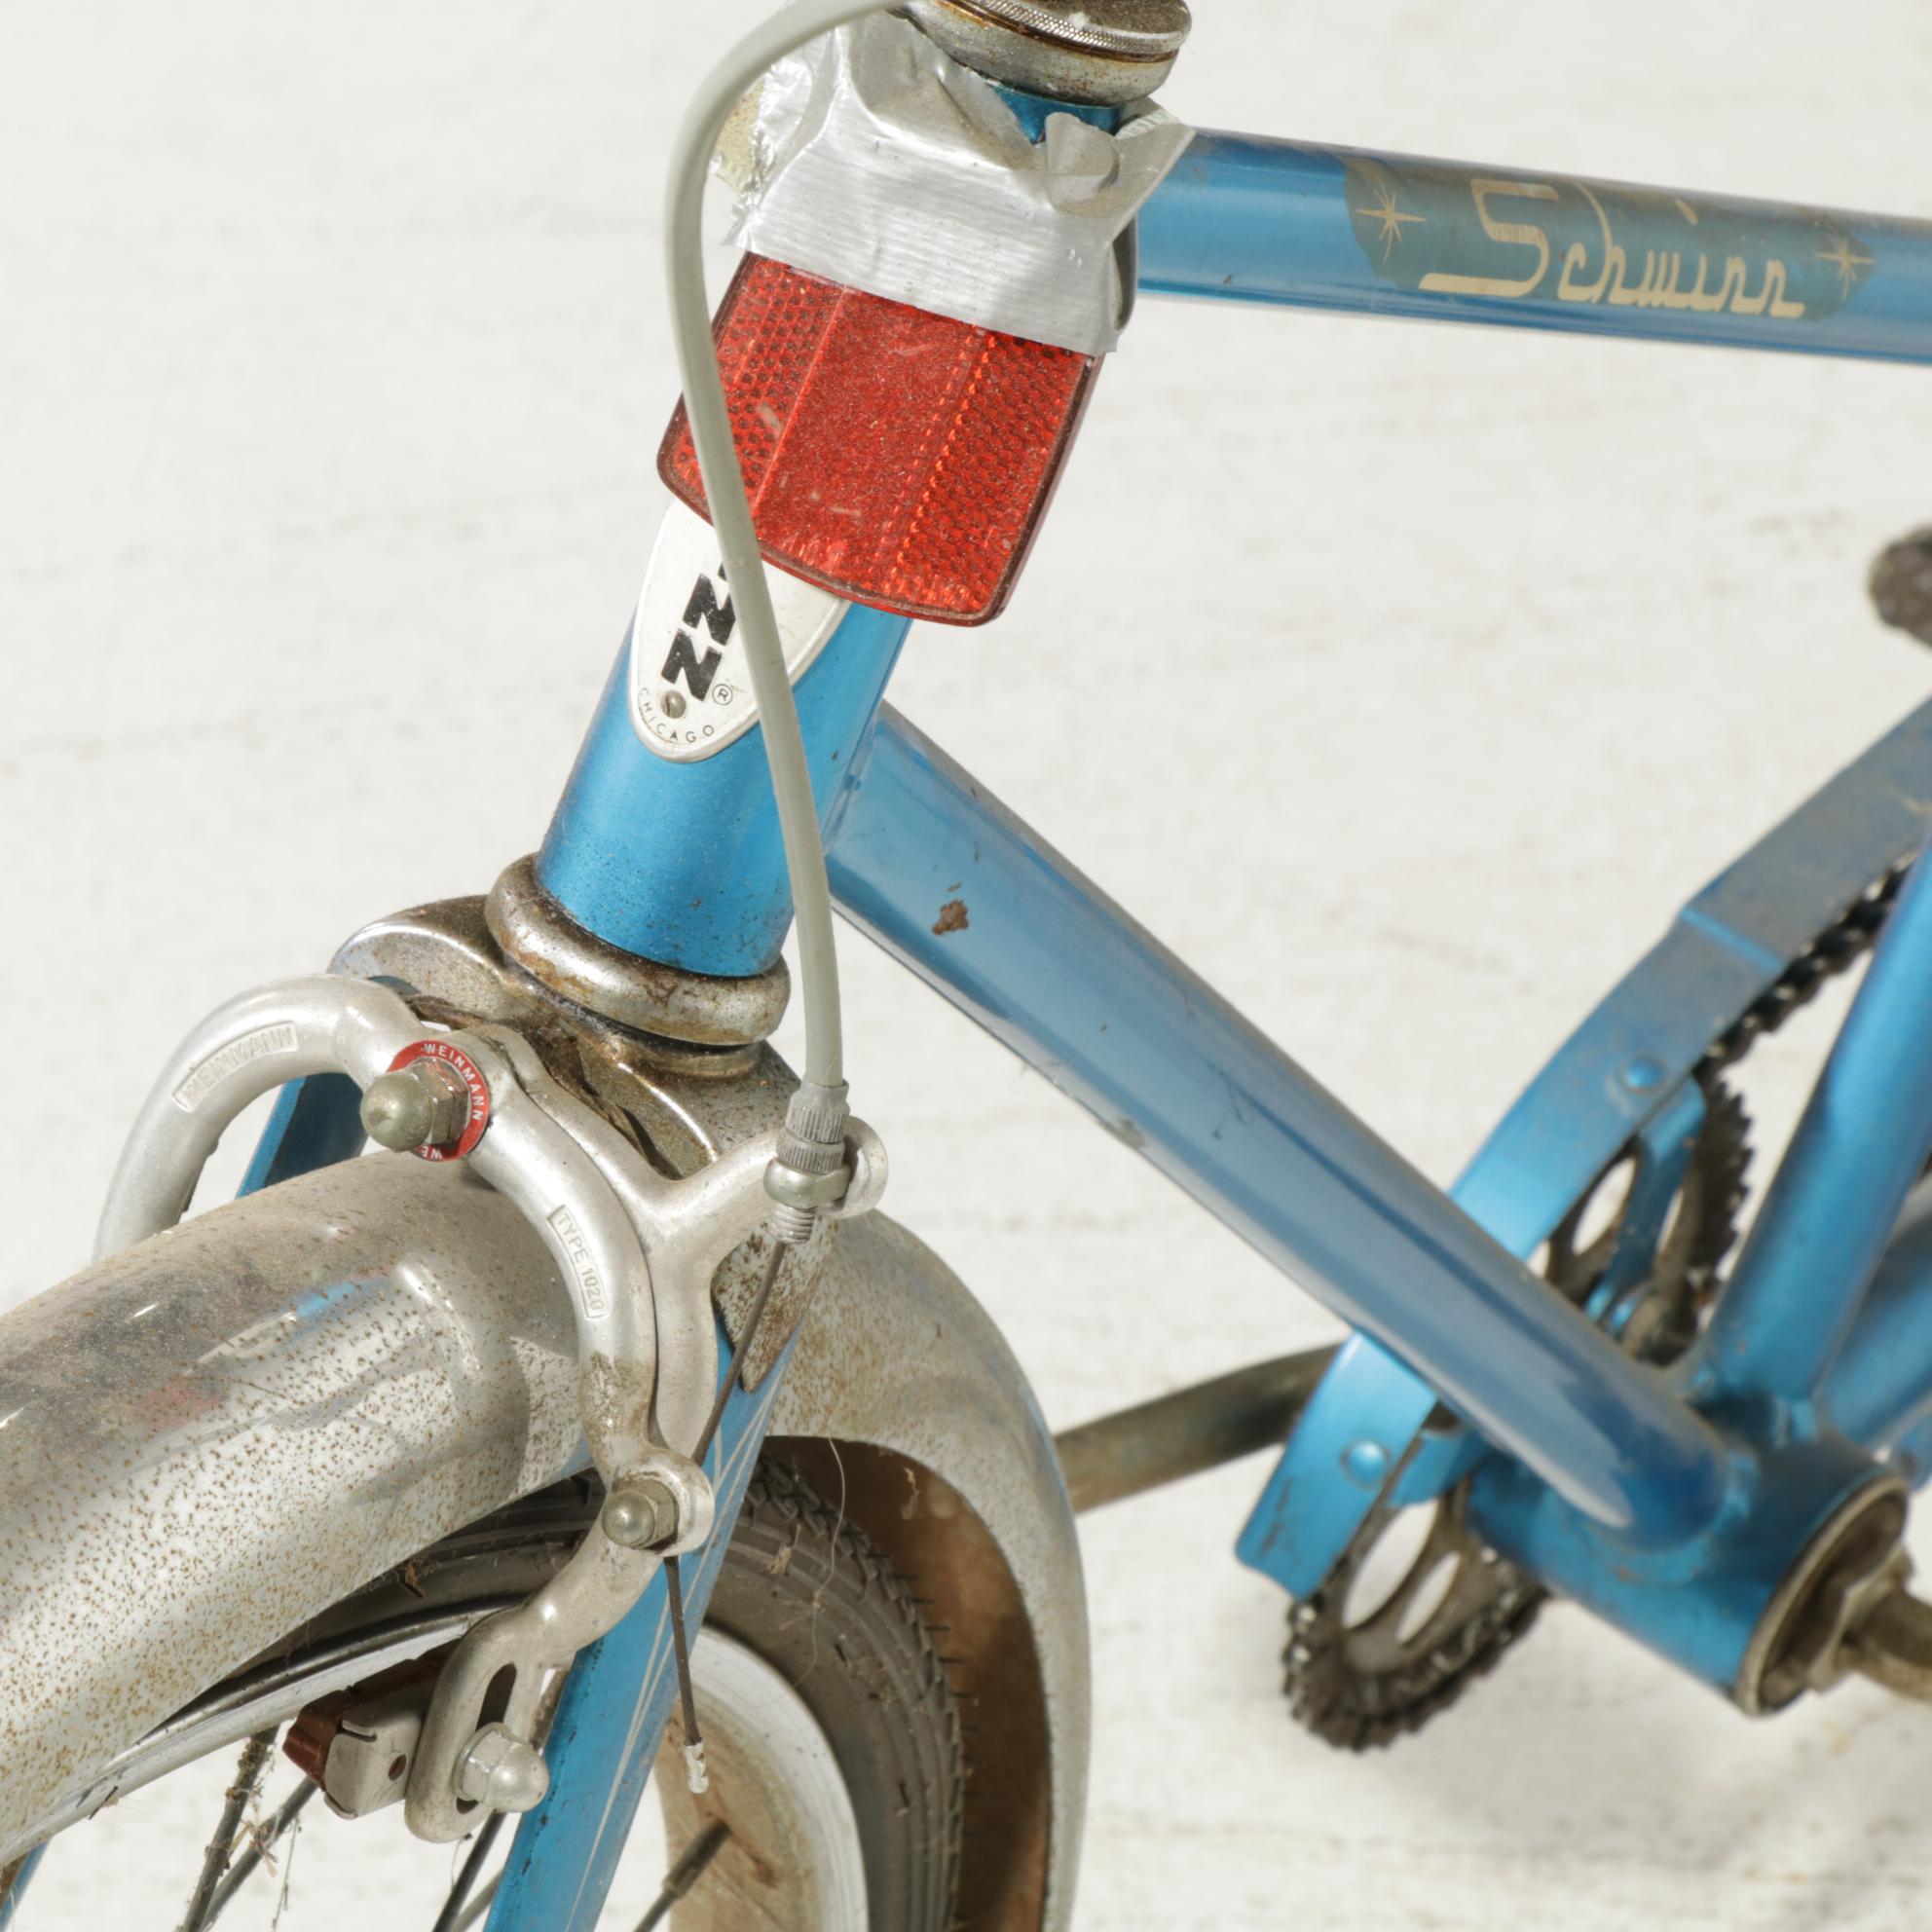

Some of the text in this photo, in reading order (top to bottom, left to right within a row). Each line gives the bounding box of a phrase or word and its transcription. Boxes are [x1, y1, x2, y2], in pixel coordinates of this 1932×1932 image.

[1419, 177, 1804, 319] Schwinn
[639, 687, 715, 744] CHICAGO
[424, 1043, 485, 1121] WEINMANN
[558, 1212, 606, 1311] TYPE 1020
